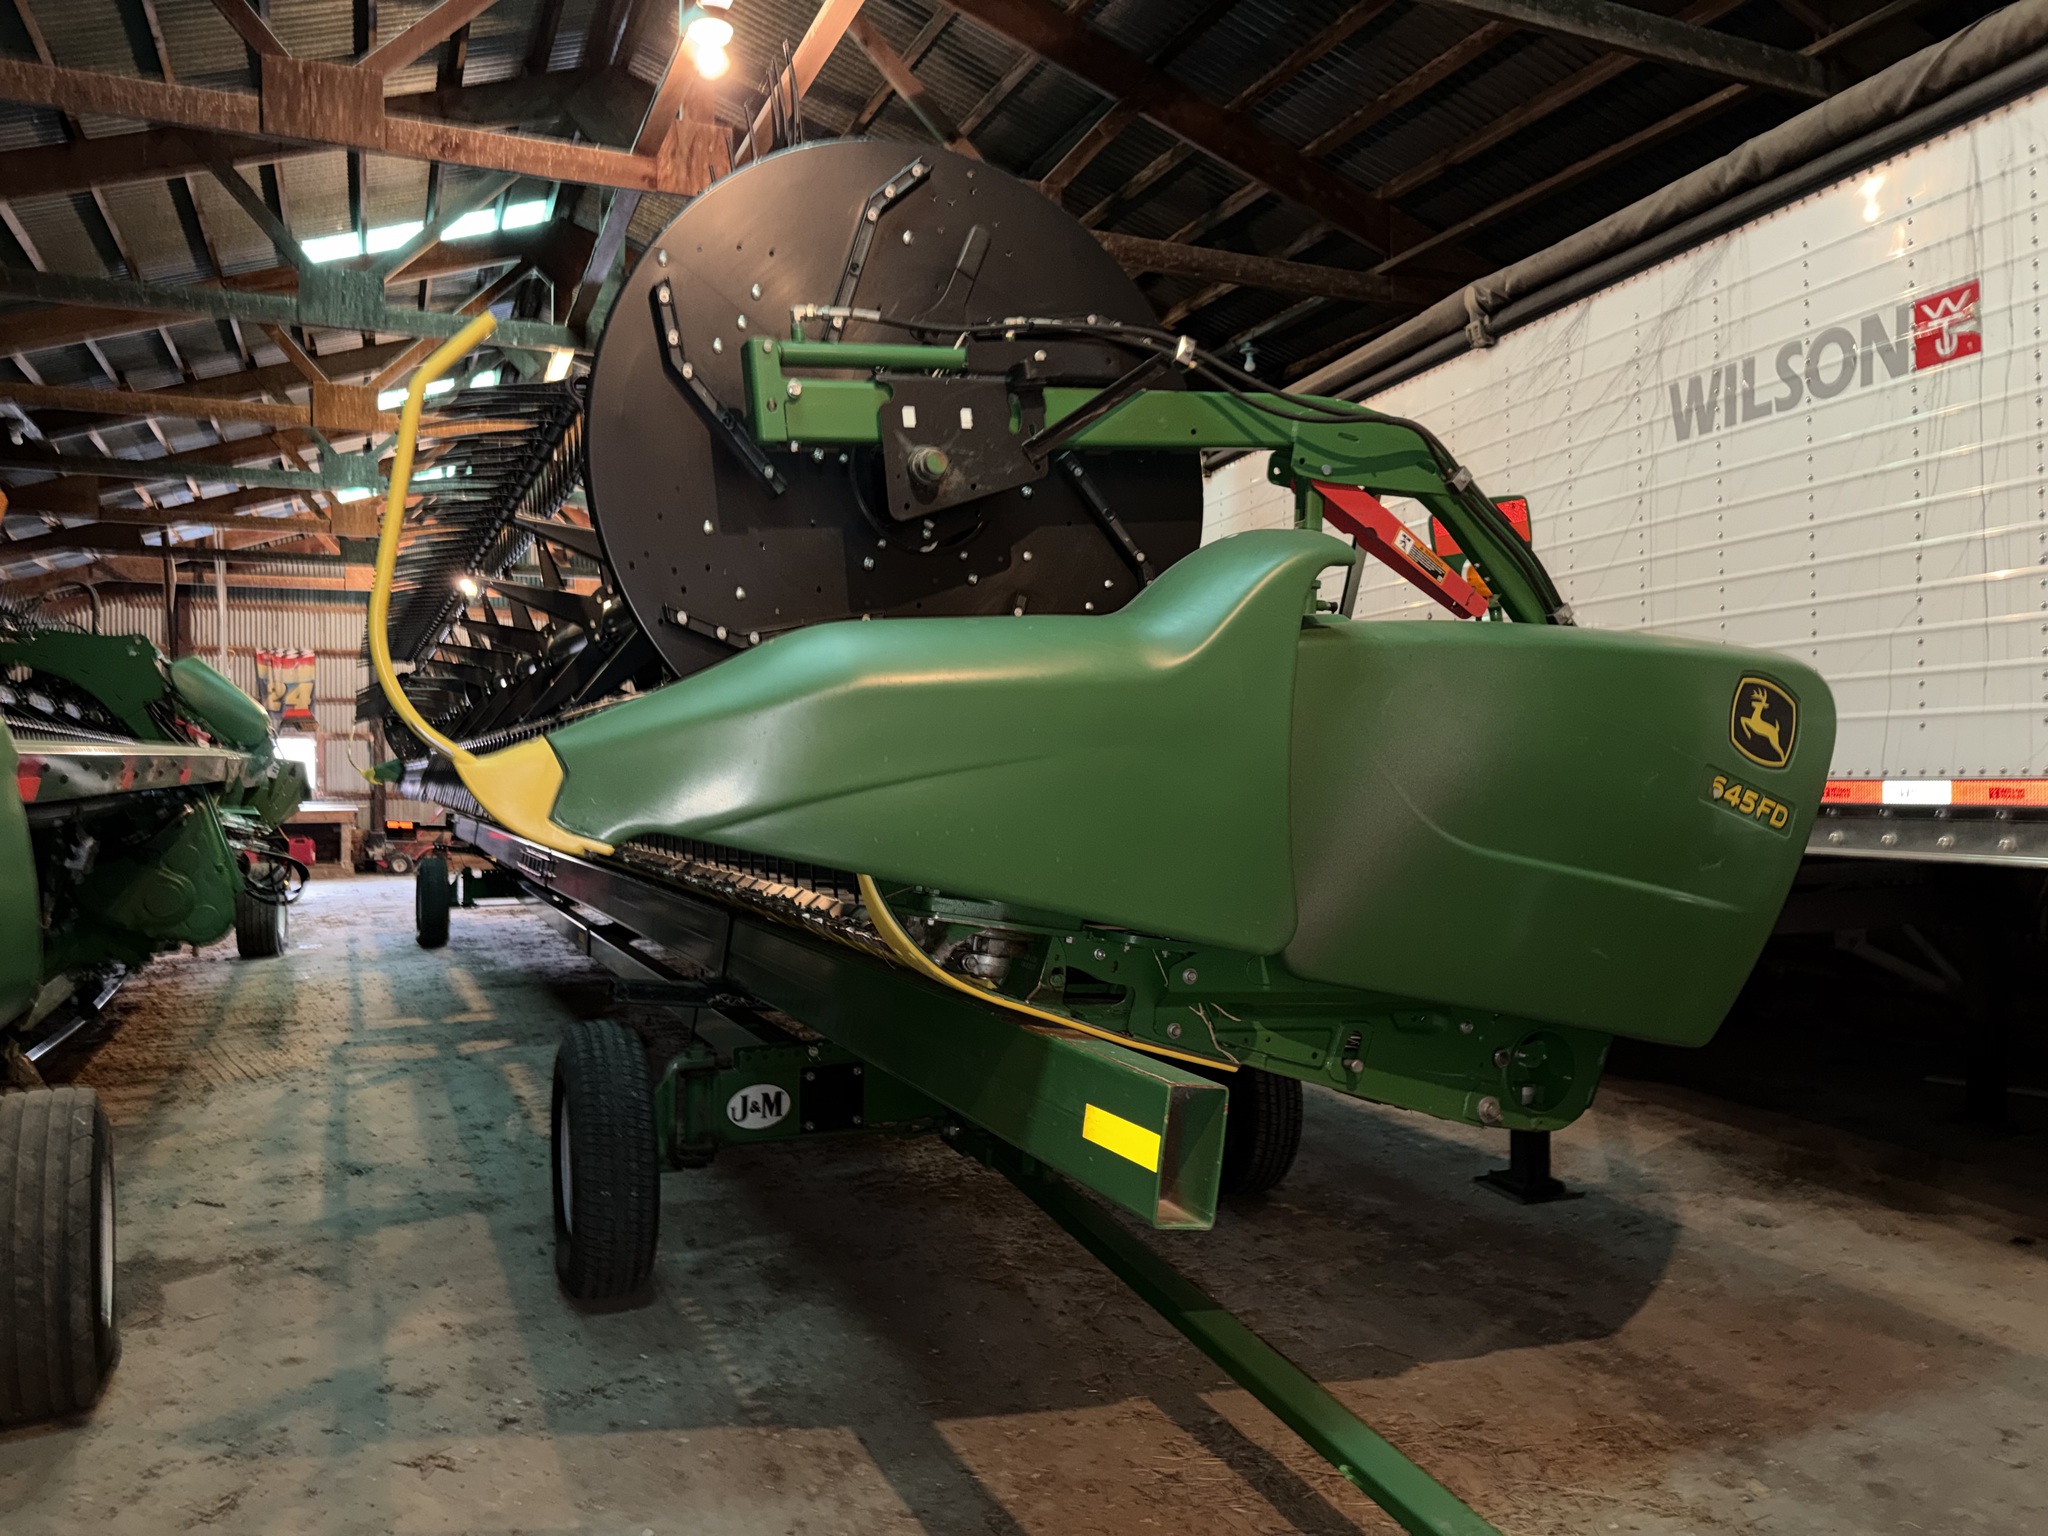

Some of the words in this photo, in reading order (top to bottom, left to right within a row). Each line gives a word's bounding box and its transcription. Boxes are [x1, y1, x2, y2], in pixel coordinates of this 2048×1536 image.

[1669, 303, 1911, 442] WILSON
[267, 681, 314, 712] 24
[1712, 775, 1789, 829] 645FD
[731, 1091, 785, 1122] J&M
